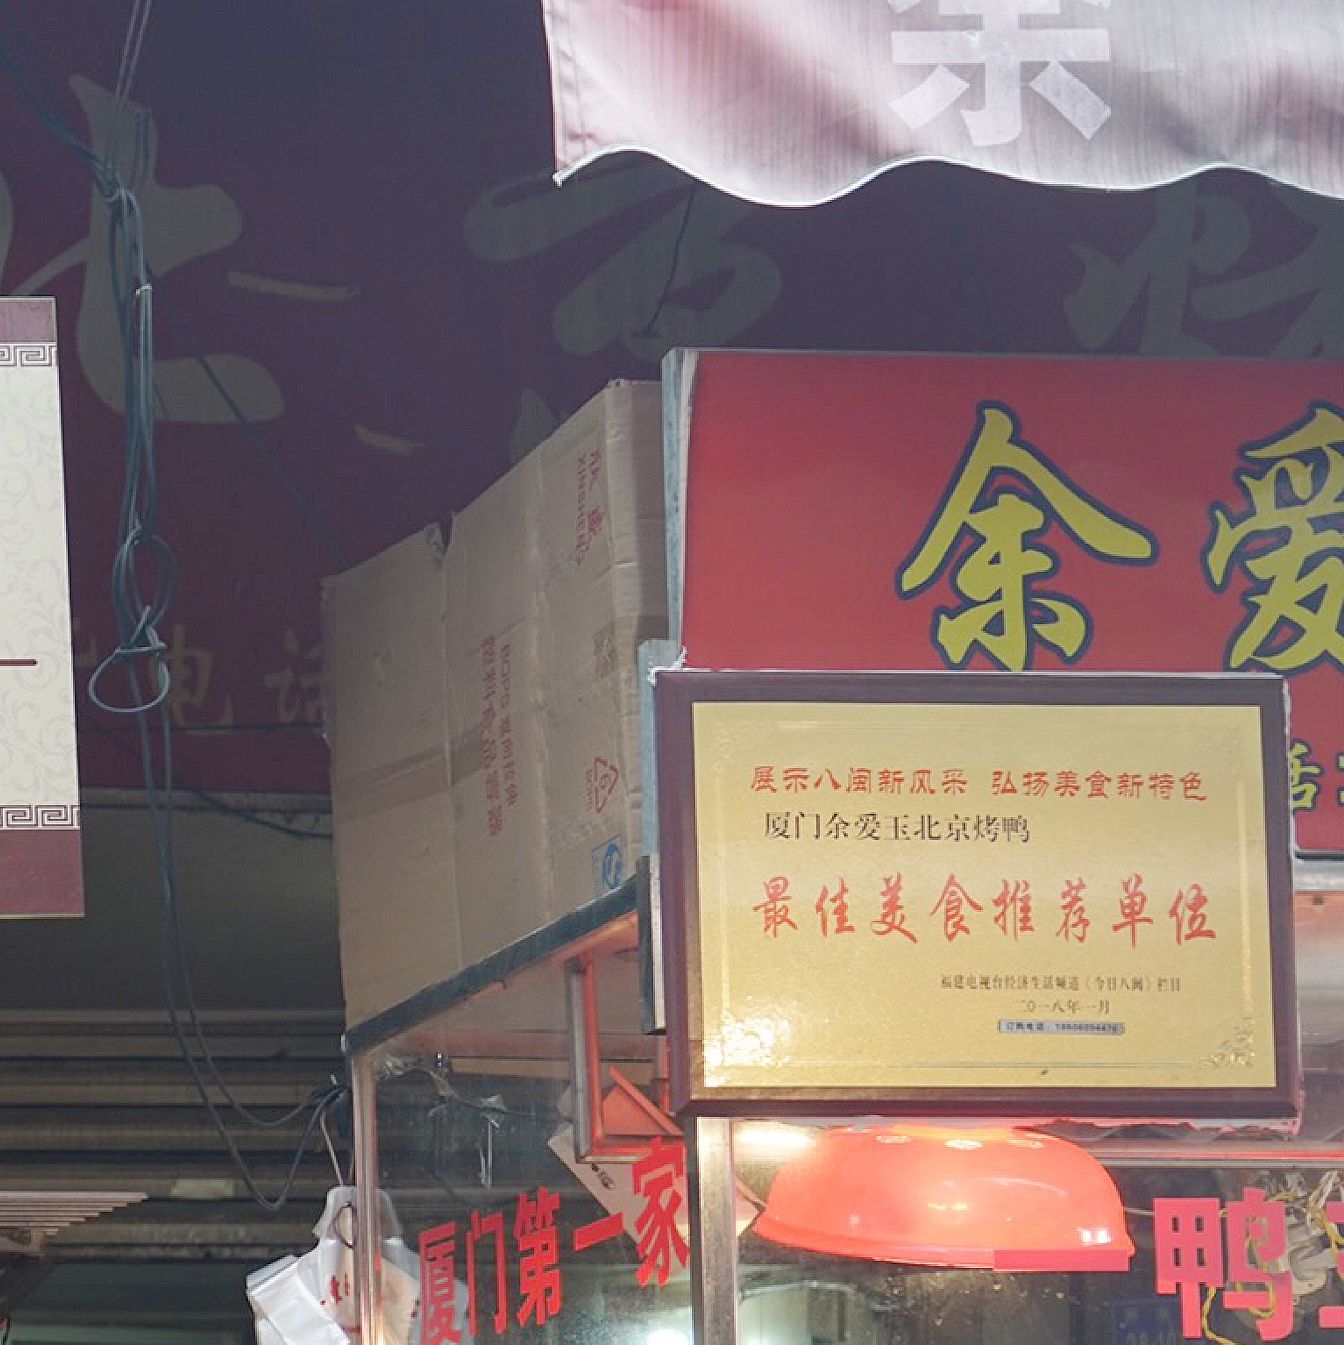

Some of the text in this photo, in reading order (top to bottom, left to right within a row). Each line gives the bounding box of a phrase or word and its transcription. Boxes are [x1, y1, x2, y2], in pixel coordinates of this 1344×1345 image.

[751, 765, 1208, 802] 展示八闽新风采 弘扬美食新特色
[764, 811, 1030, 843] 厦门余爱玉北京烤鸭
[752, 872, 1217, 949] 最佳美食推荐单位
[1153, 1186, 1344, 1341] 鸭
